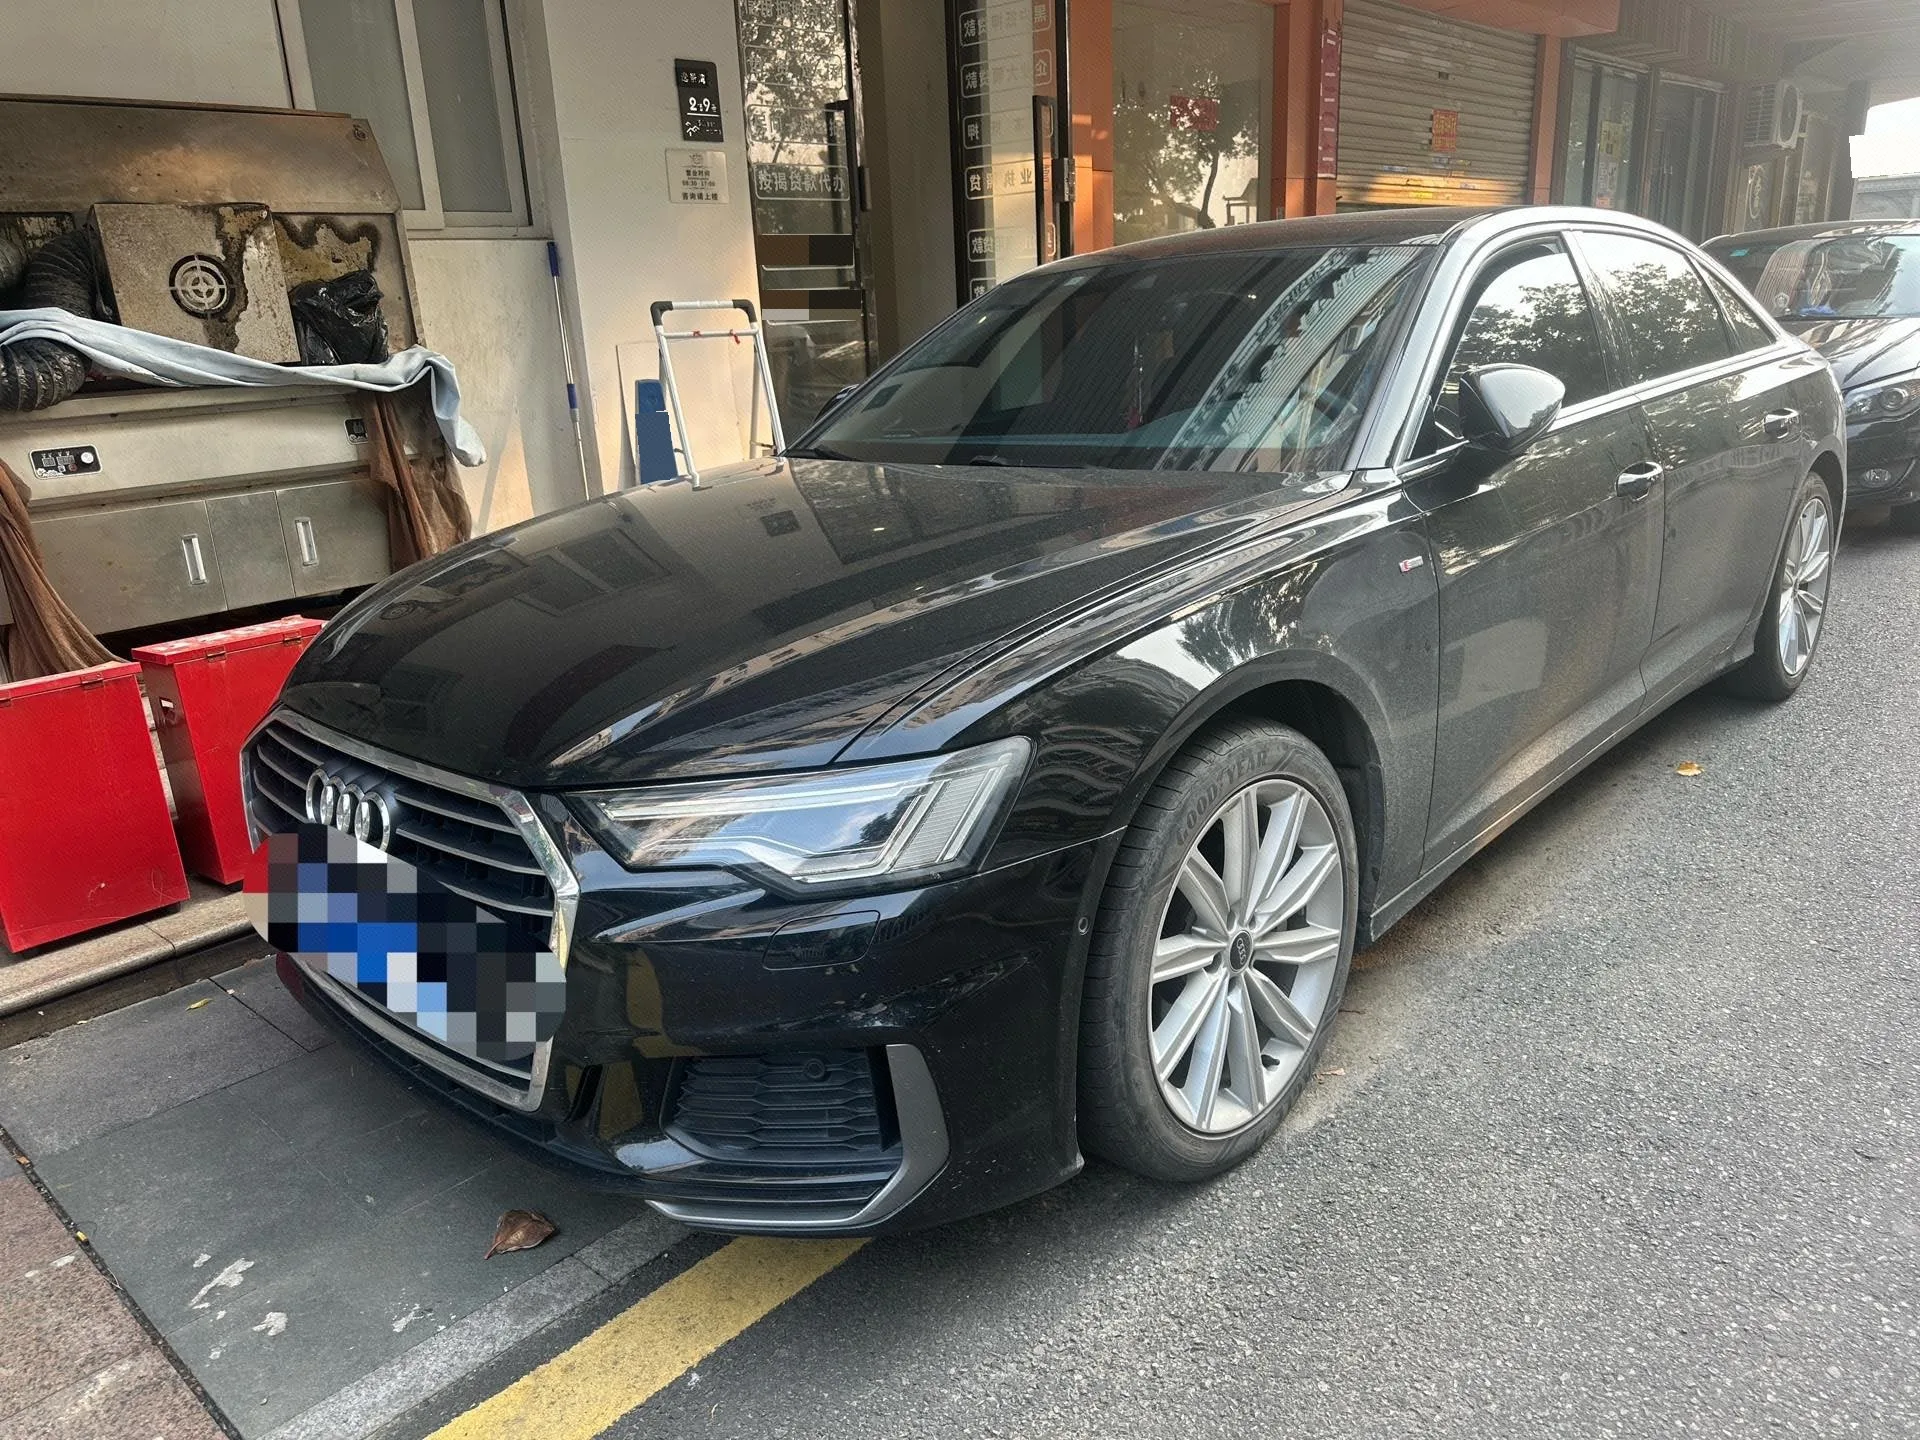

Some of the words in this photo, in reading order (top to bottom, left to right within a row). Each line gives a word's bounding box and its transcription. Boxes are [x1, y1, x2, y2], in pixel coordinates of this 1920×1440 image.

[758, 170, 845, 193] 按揭贷款代办
[1175, 750, 1268, 846] GOODYEAR
